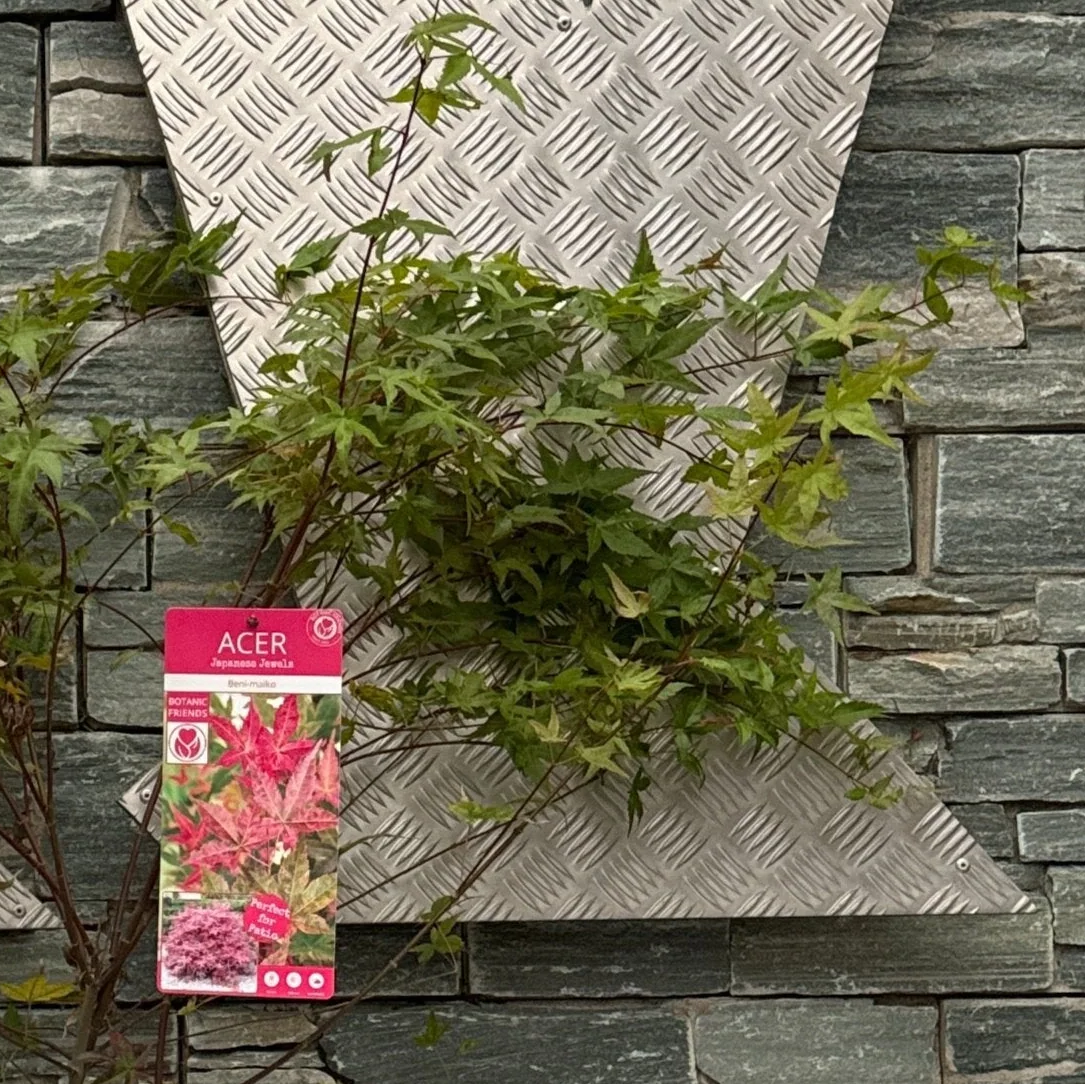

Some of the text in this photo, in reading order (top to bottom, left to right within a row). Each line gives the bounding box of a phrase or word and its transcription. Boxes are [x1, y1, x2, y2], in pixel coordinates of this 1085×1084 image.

[217, 631, 287, 655] ACER
[210, 657, 294, 670] Japanese Jewels
[227, 679, 277, 689] Beni-maiko
[168, 697, 208, 706] BOTANIC
[168, 709, 208, 718] FRIENDS
[250, 897, 291, 920] Perfect
[257, 913, 277, 926] for
